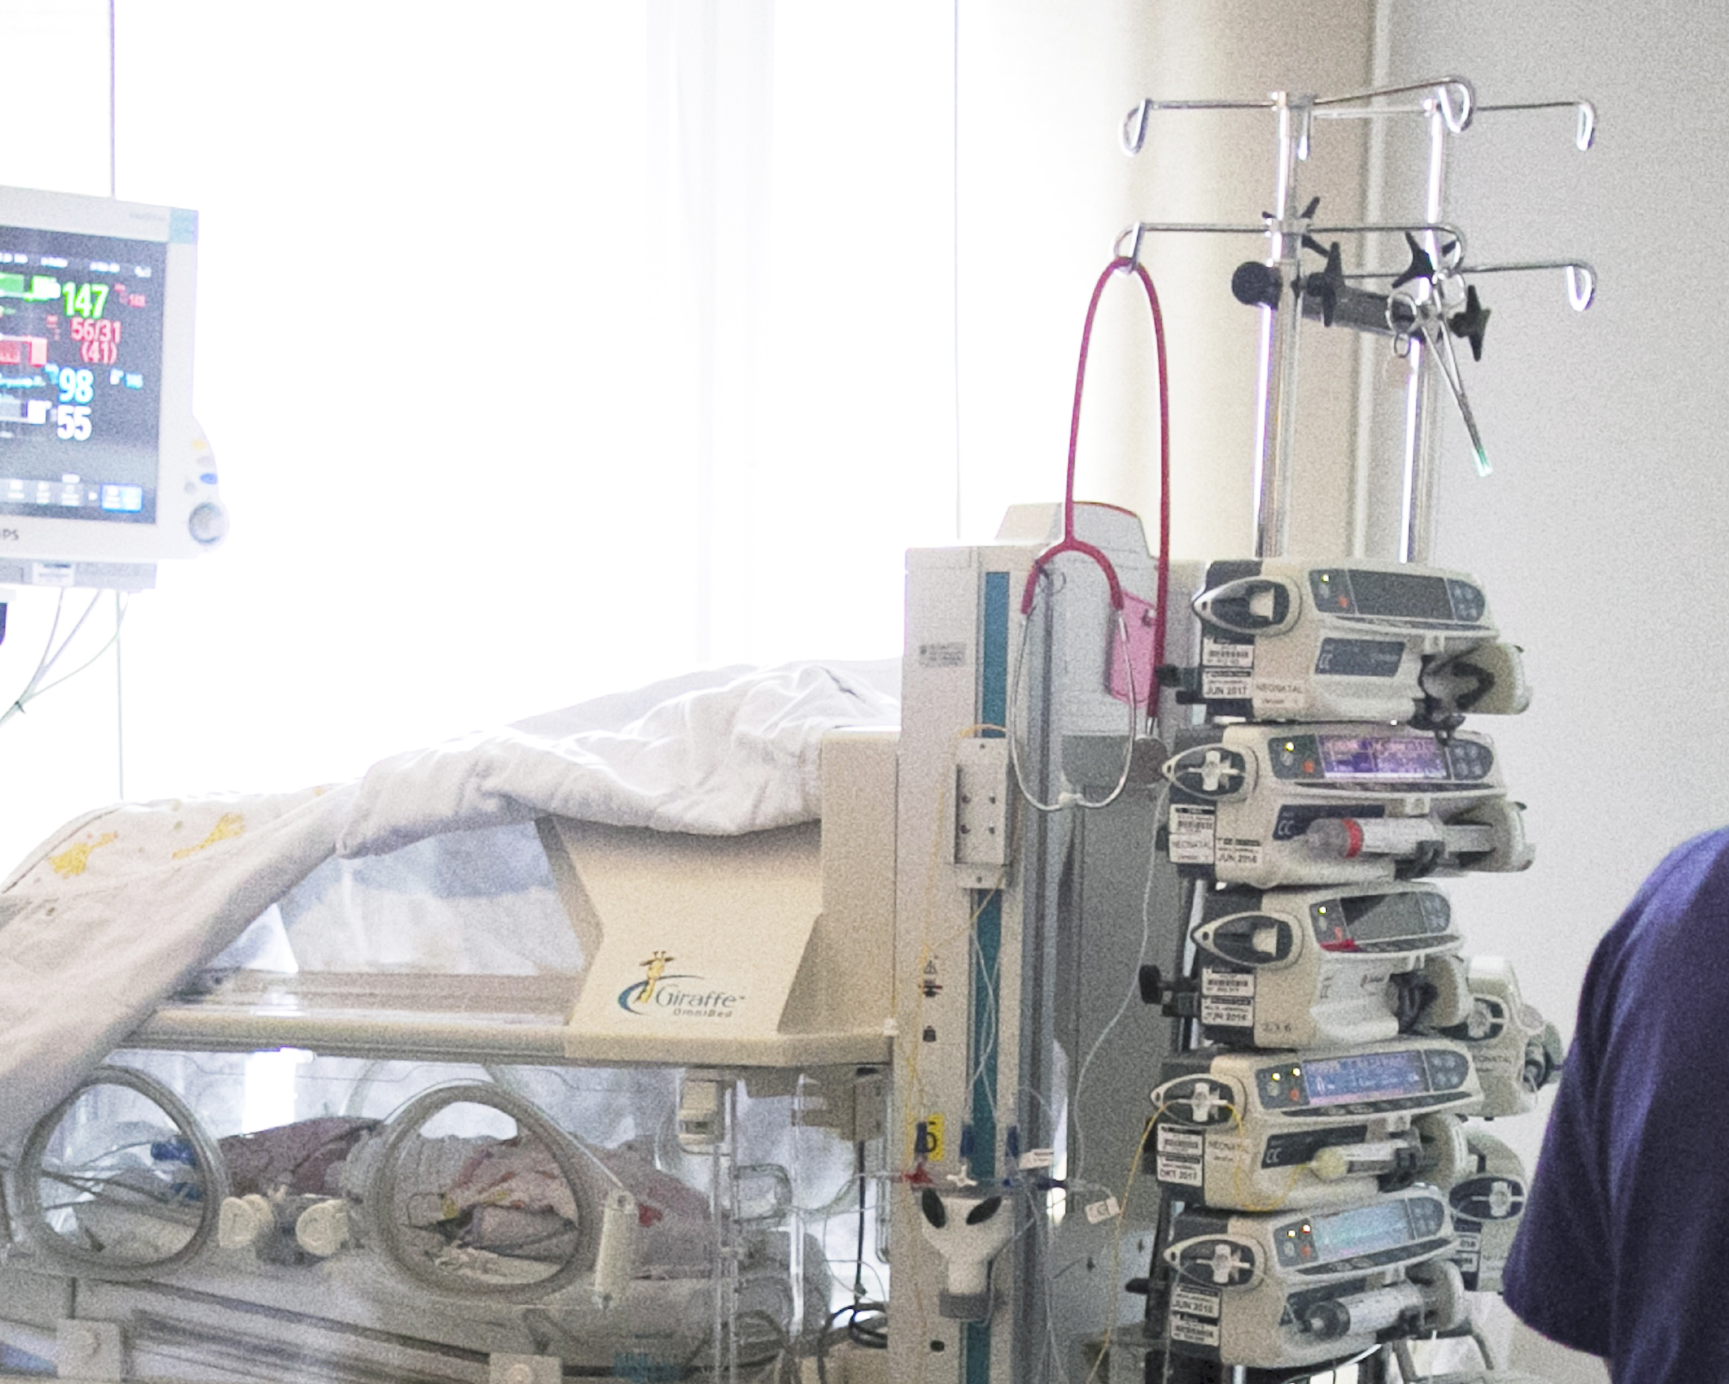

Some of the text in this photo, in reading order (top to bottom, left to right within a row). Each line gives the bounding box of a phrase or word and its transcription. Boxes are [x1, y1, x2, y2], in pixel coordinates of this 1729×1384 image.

[62, 281, 109, 319] 147
[71, 317, 121, 344] 56/31
[79, 341, 118, 364] (41)
[58, 366, 94, 405] 98
[56, 404, 92, 441] 55
[1205, 686, 1224, 695] JUN
[655, 983, 737, 1008] Giraffe
[673, 1008, 733, 1018] OmniBed
